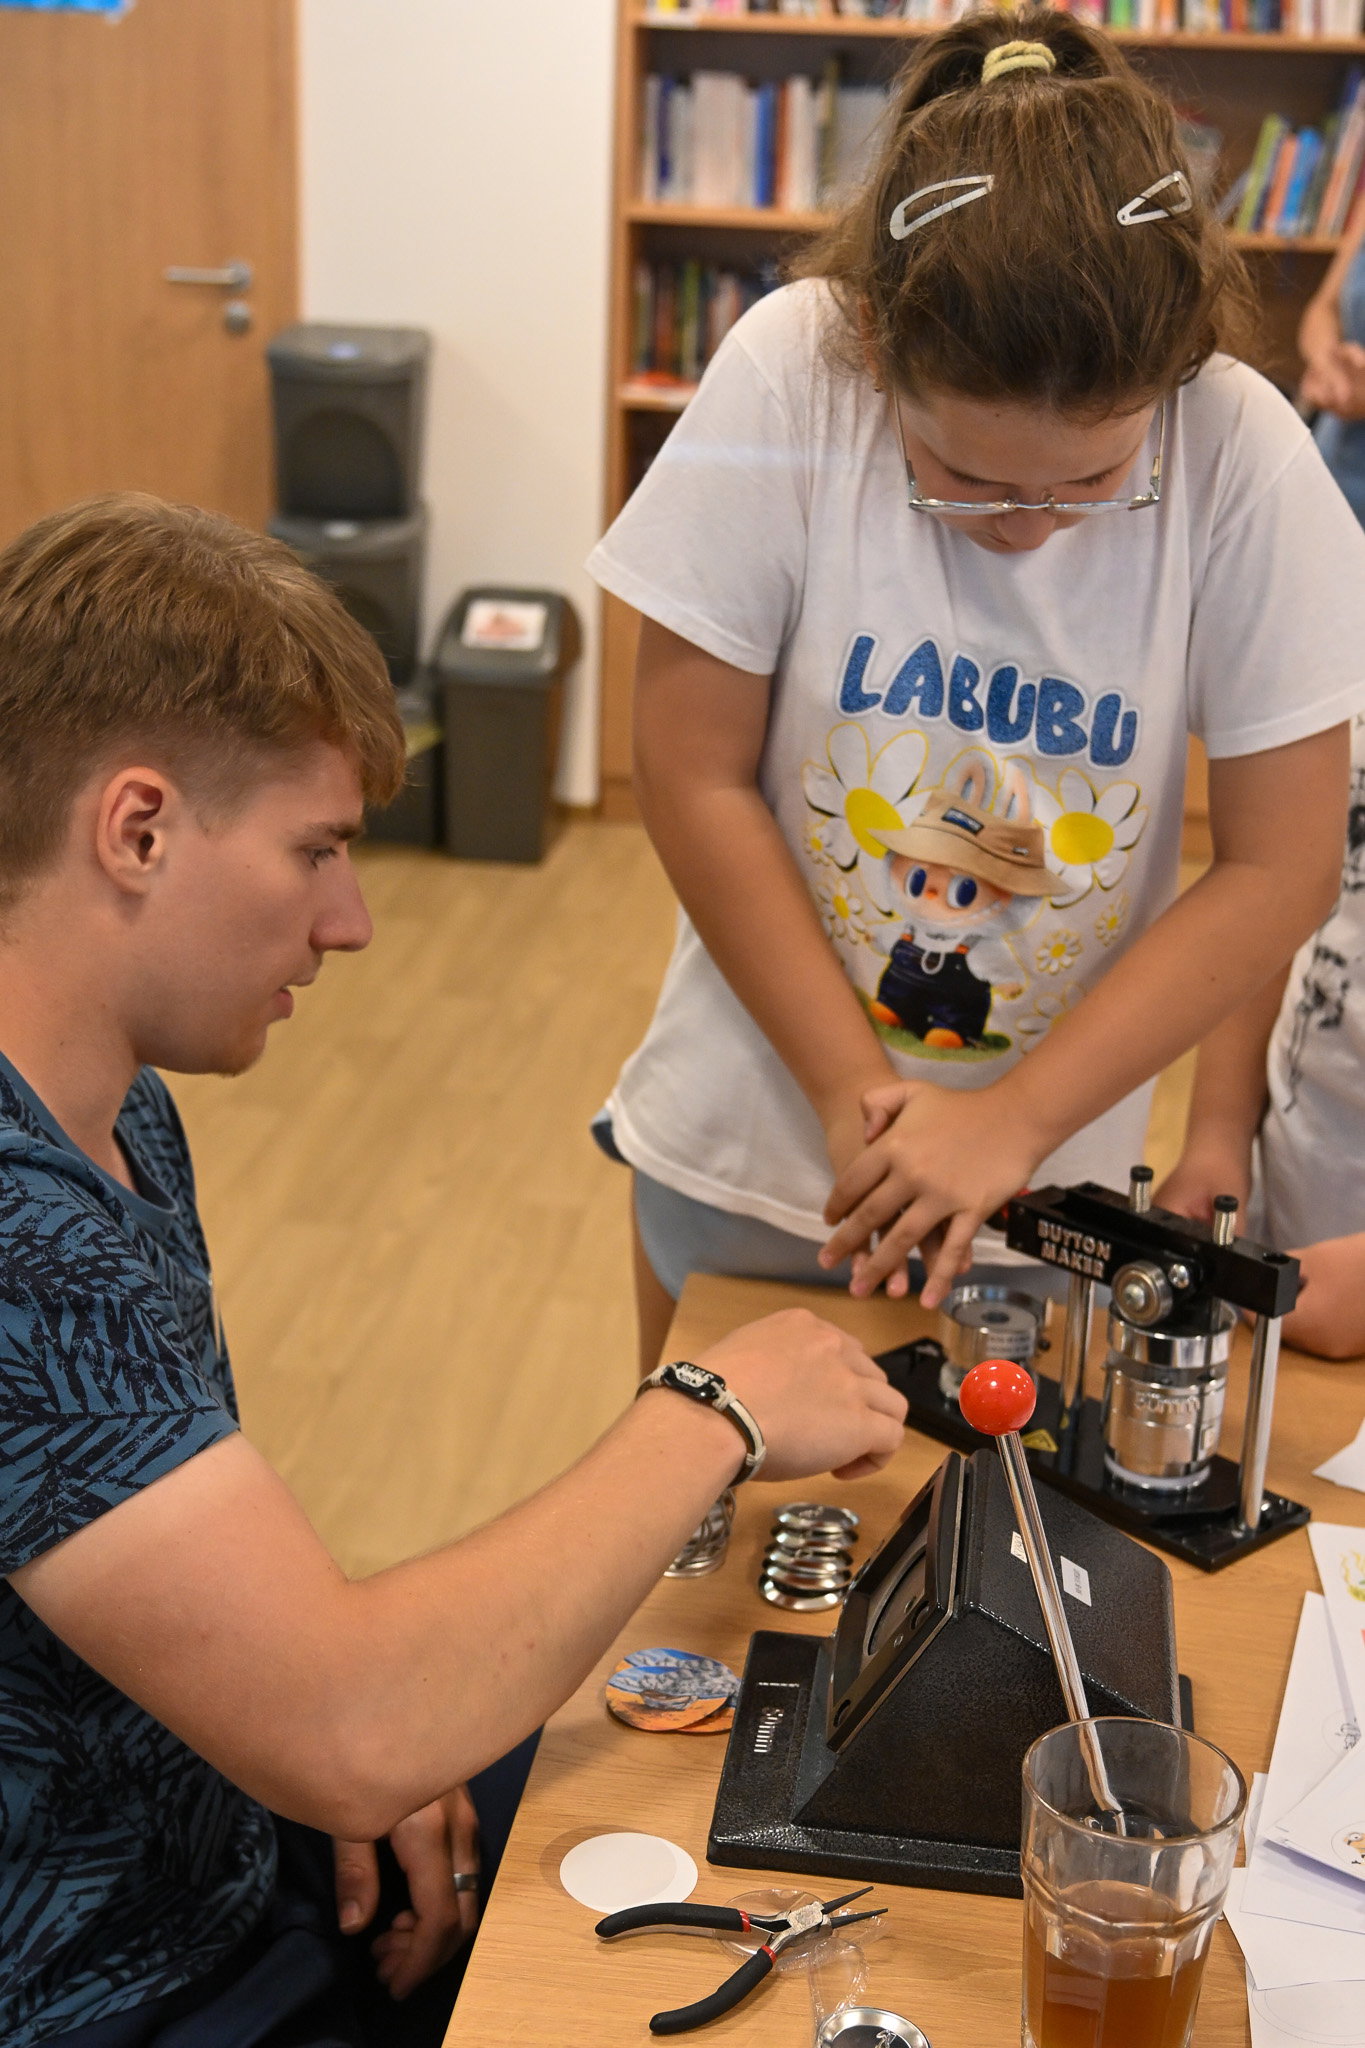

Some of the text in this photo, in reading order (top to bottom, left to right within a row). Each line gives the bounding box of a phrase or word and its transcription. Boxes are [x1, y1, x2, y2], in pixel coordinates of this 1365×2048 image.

[838, 634, 1138, 767] LABUBU
[1038, 1219, 1111, 1261] BUTTON
[1041, 1240, 1105, 1278] MAKER
